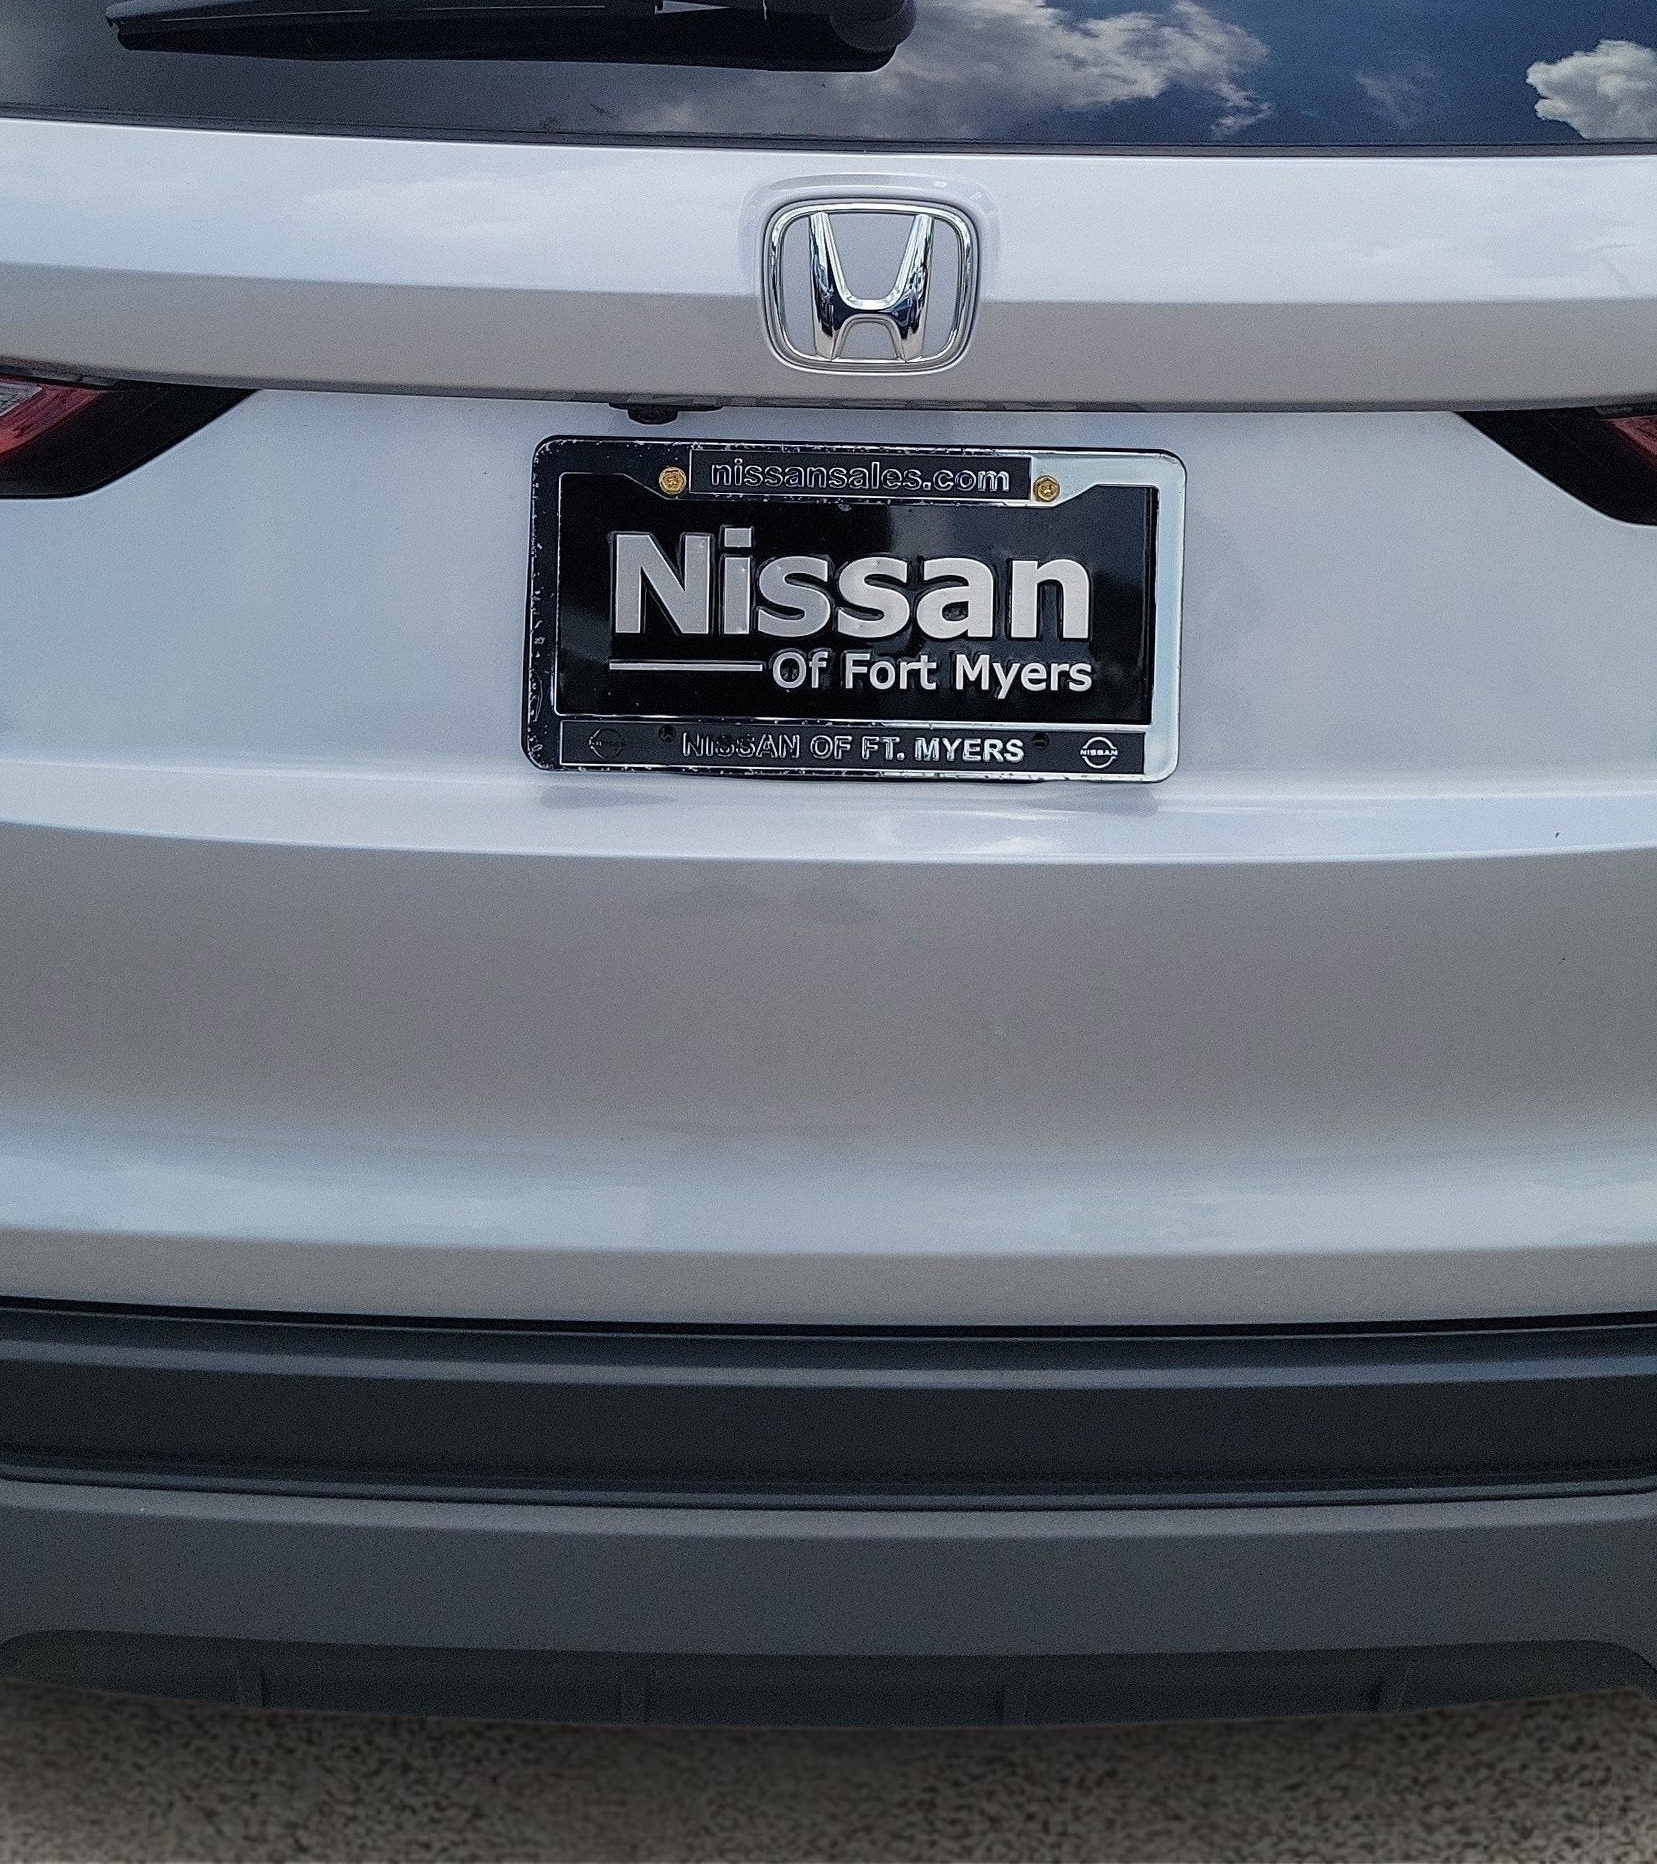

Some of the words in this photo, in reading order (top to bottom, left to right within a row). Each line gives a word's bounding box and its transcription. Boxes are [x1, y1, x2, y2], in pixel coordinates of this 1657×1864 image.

[710, 458, 1011, 494] nissansales.com
[613, 527, 1093, 640] Nissan
[772, 650, 826, 690] Of
[845, 652, 937, 692] Fort
[954, 654, 1094, 700] Myers
[681, 732, 801, 759] NISSAN
[810, 735, 852, 760] OF
[861, 736, 906, 761] FT.
[914, 737, 1025, 764] MYERS
[1079, 747, 1119, 757] NISSAN
